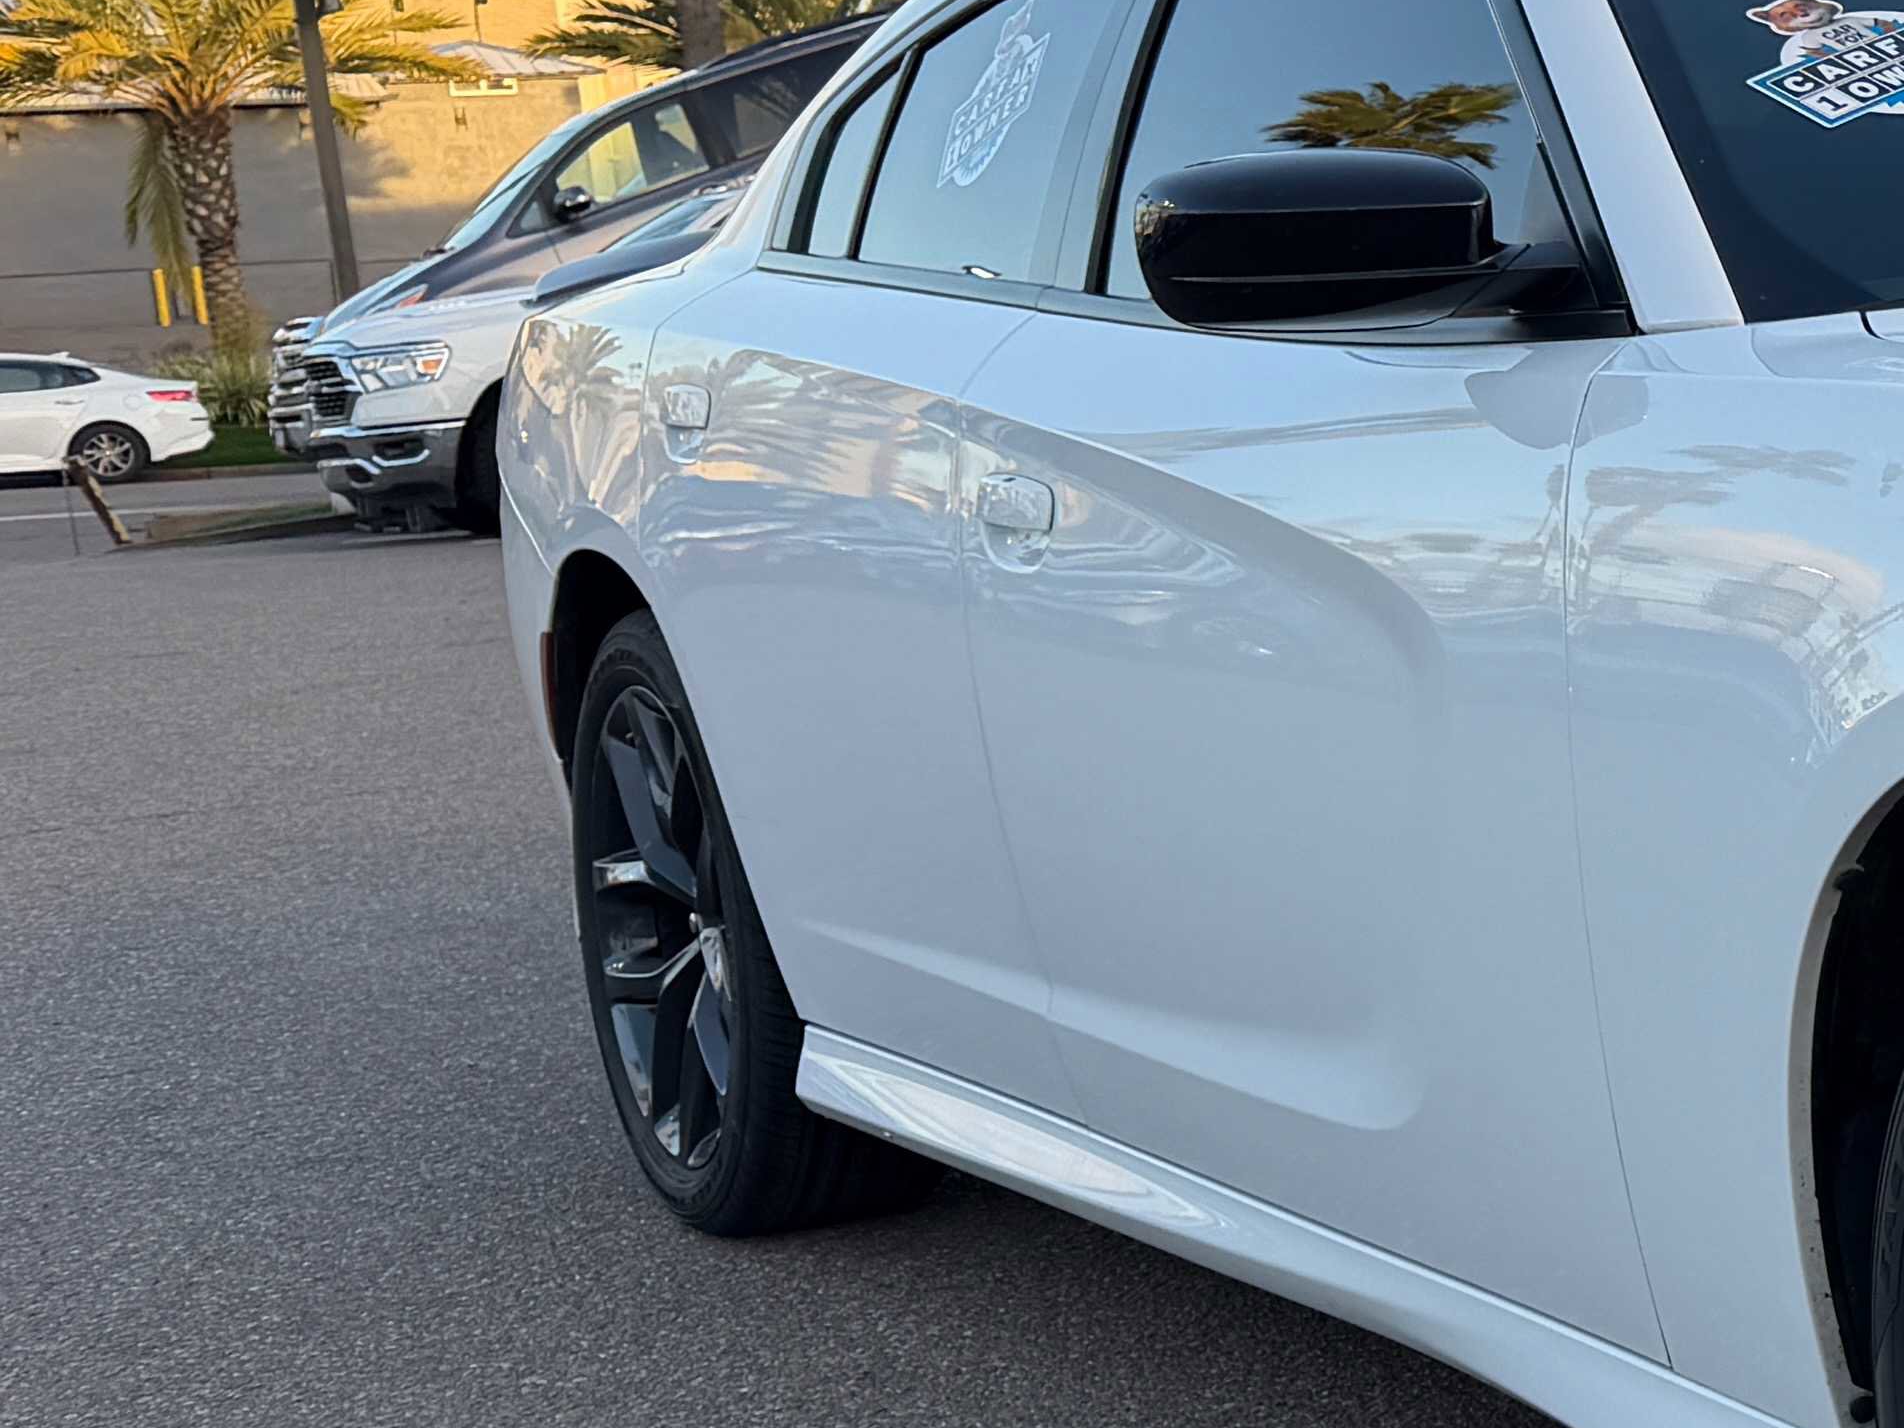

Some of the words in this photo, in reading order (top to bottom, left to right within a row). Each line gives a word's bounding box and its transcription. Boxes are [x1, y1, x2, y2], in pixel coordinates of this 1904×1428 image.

[1822, 24, 1860, 40] CAR
[1836, 32, 1868, 47] FOX
[955, 59, 1038, 135] CARFAX
[1817, 94, 1848, 112] 1
[961, 84, 1029, 154] OWNER
